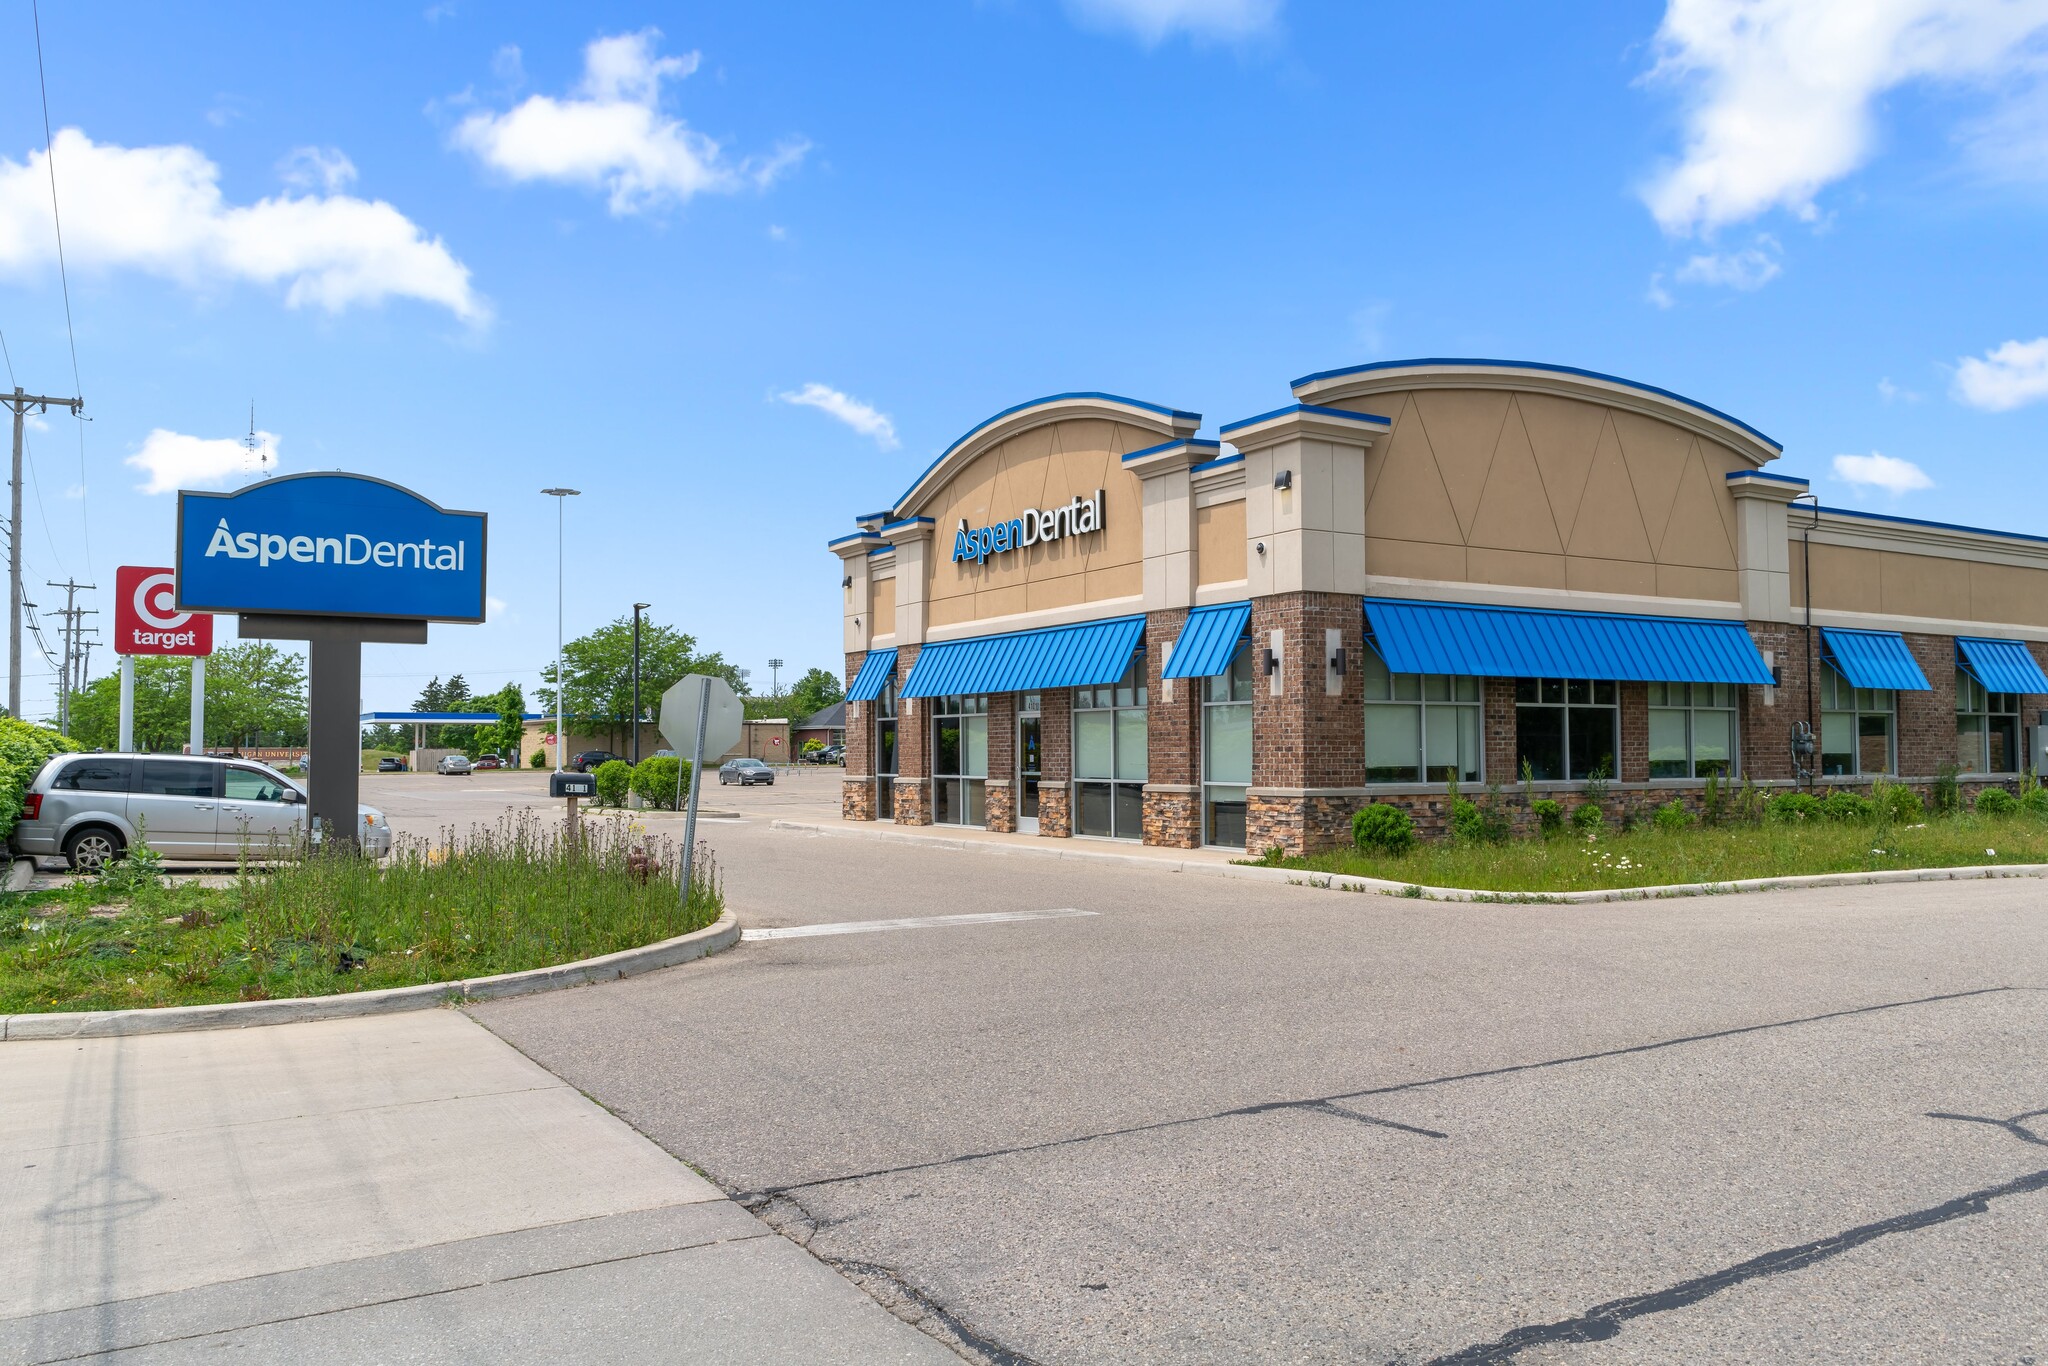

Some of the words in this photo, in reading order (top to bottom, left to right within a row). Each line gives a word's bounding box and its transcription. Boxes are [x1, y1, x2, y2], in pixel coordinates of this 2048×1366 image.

[204, 517, 465, 571] AspenDental
[952, 488, 1104, 565] AspenDental
[132, 629, 196, 649] target
